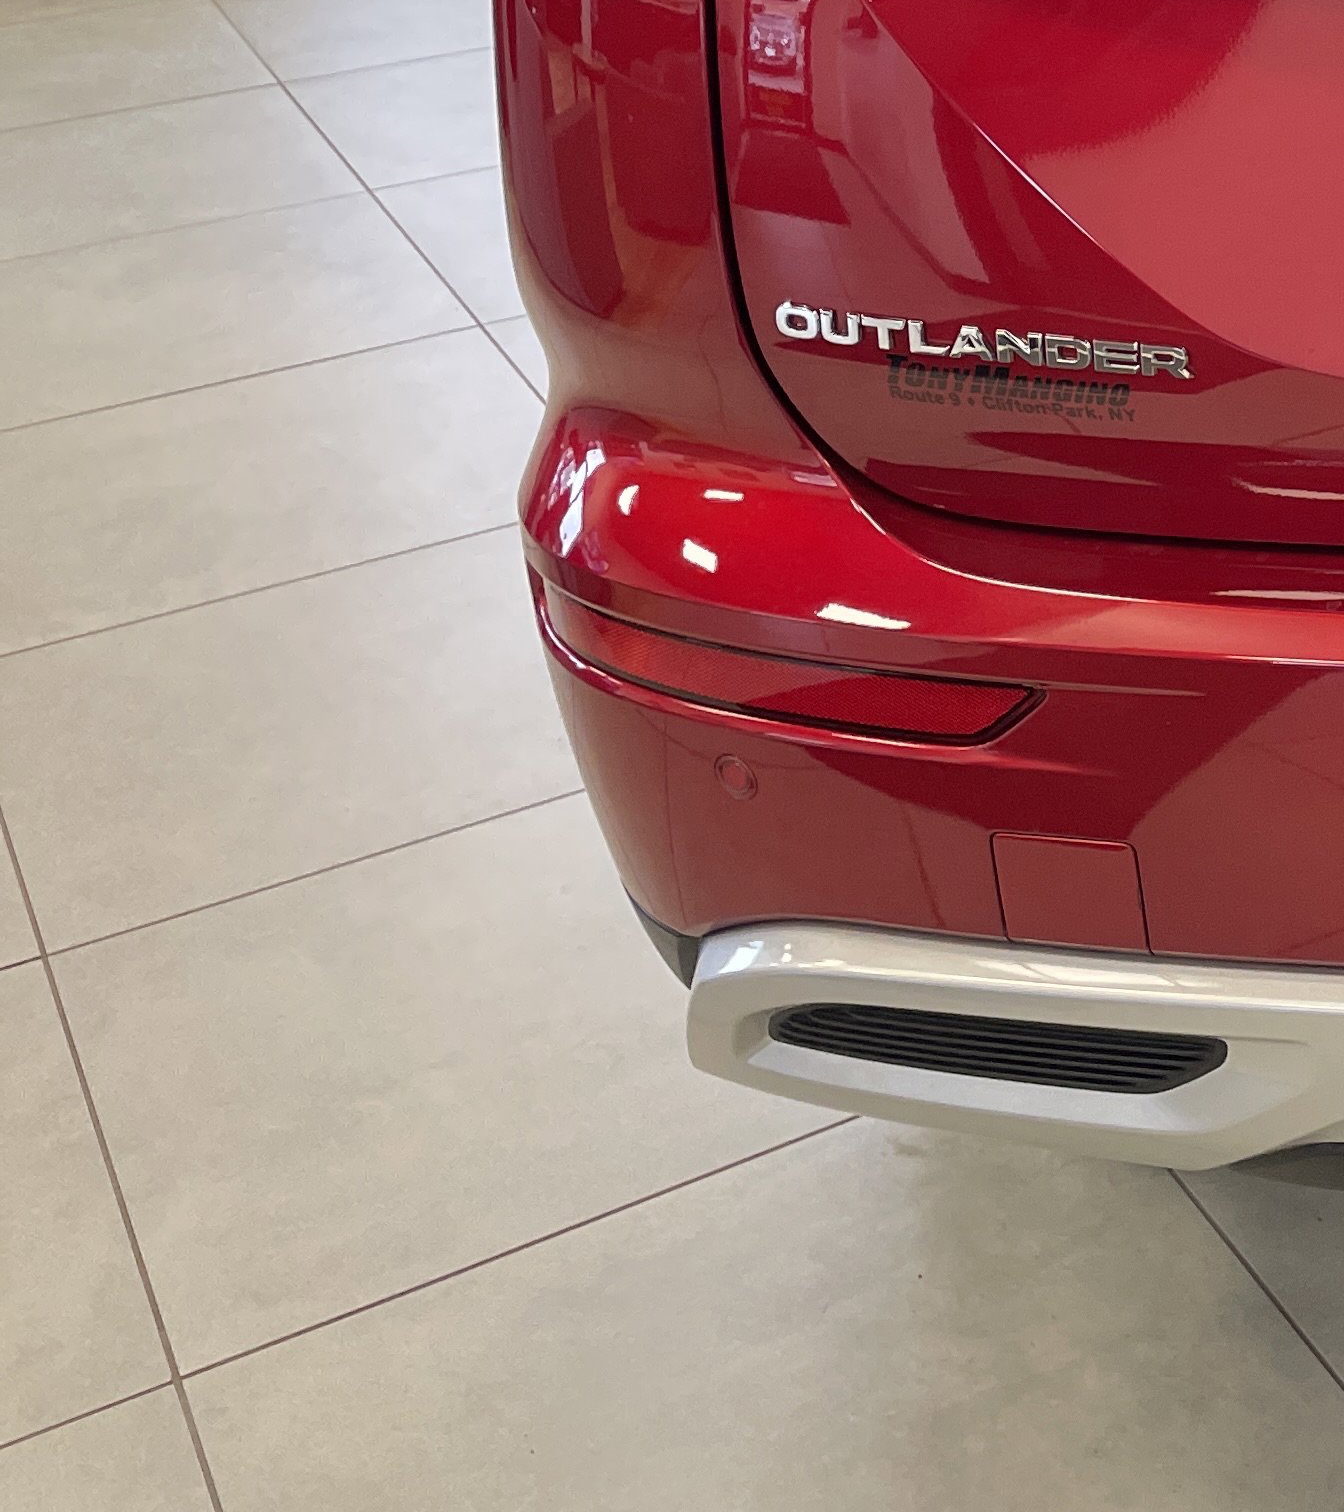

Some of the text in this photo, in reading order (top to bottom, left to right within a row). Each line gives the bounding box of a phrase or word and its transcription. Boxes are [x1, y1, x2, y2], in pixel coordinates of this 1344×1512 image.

[775, 299, 1196, 380] OUTLANDER
[890, 387, 945, 406] Route
[981, 395, 1049, 415] Clifton
[1108, 407, 1136, 422] NY
